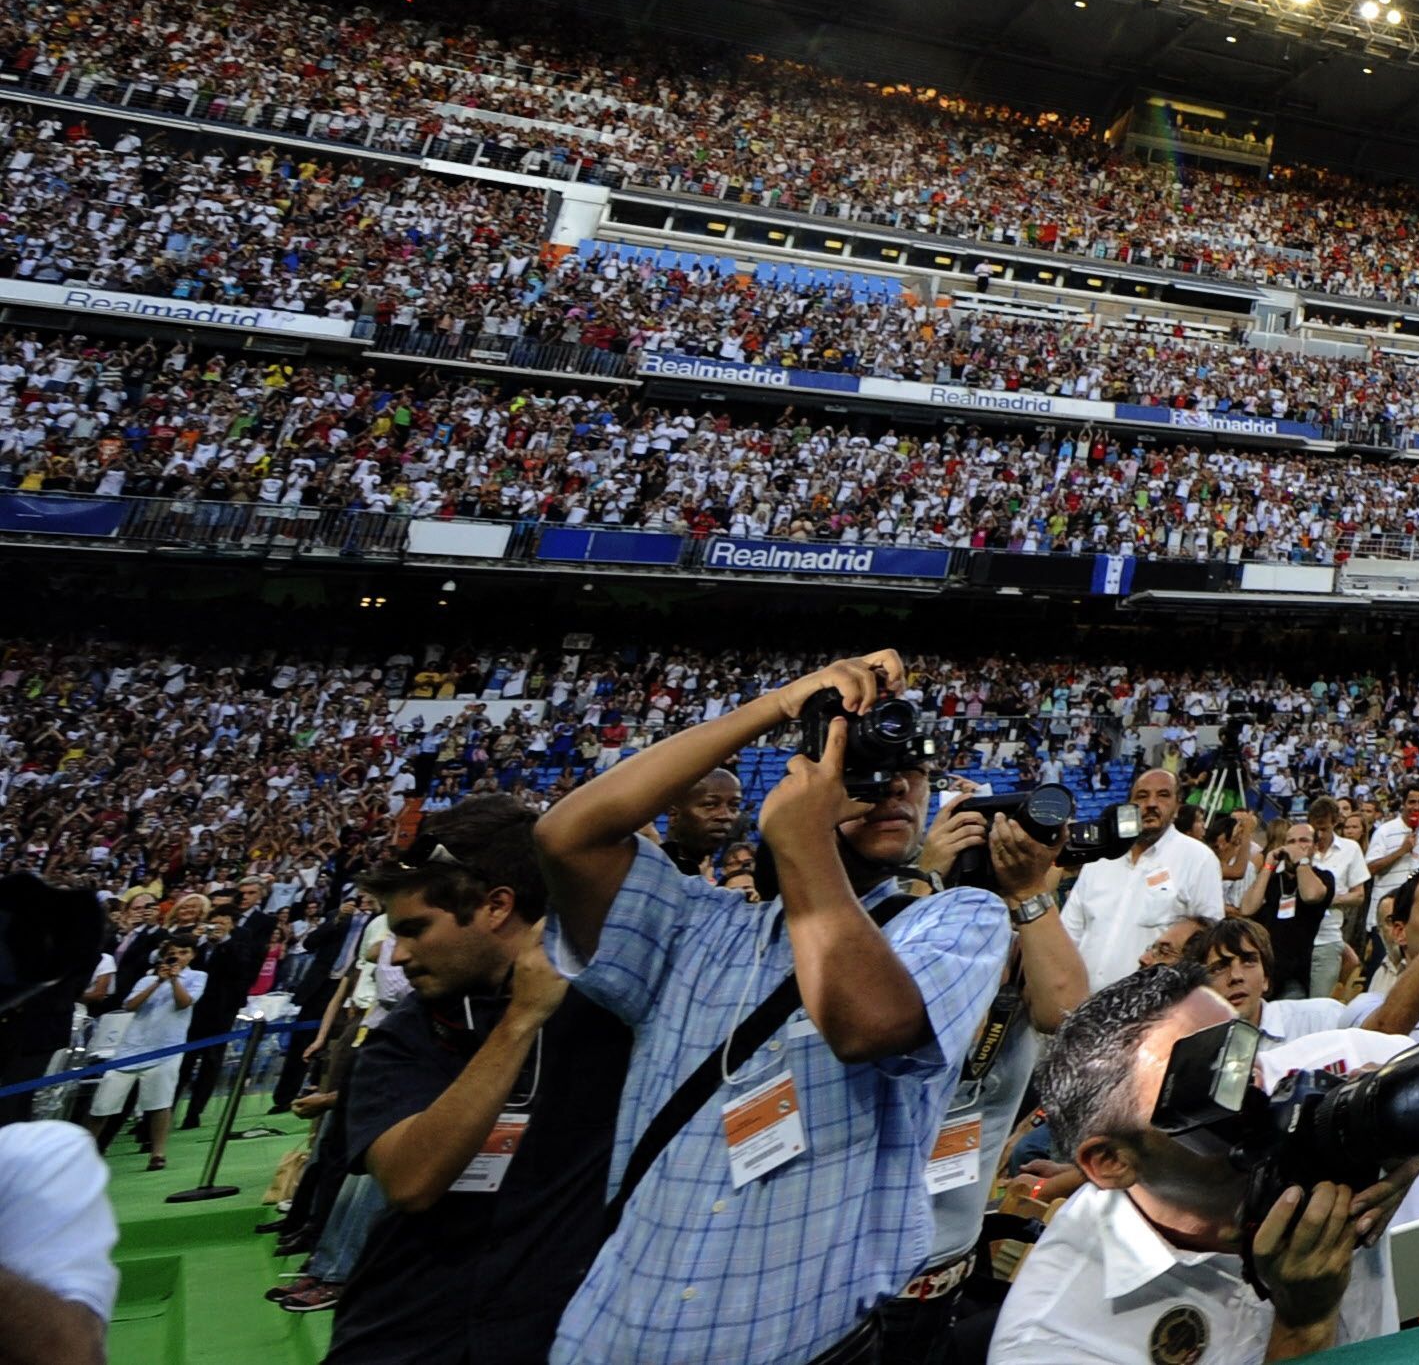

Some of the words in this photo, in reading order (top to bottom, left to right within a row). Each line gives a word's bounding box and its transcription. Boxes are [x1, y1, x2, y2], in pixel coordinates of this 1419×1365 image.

[65, 291, 261, 328] Realmadrid
[645, 353, 788, 386] Realmadrid
[931, 388, 1050, 413] Realmadrid
[713, 542, 872, 572] Realmadrid
[977, 1023, 1004, 1060] Nikon
